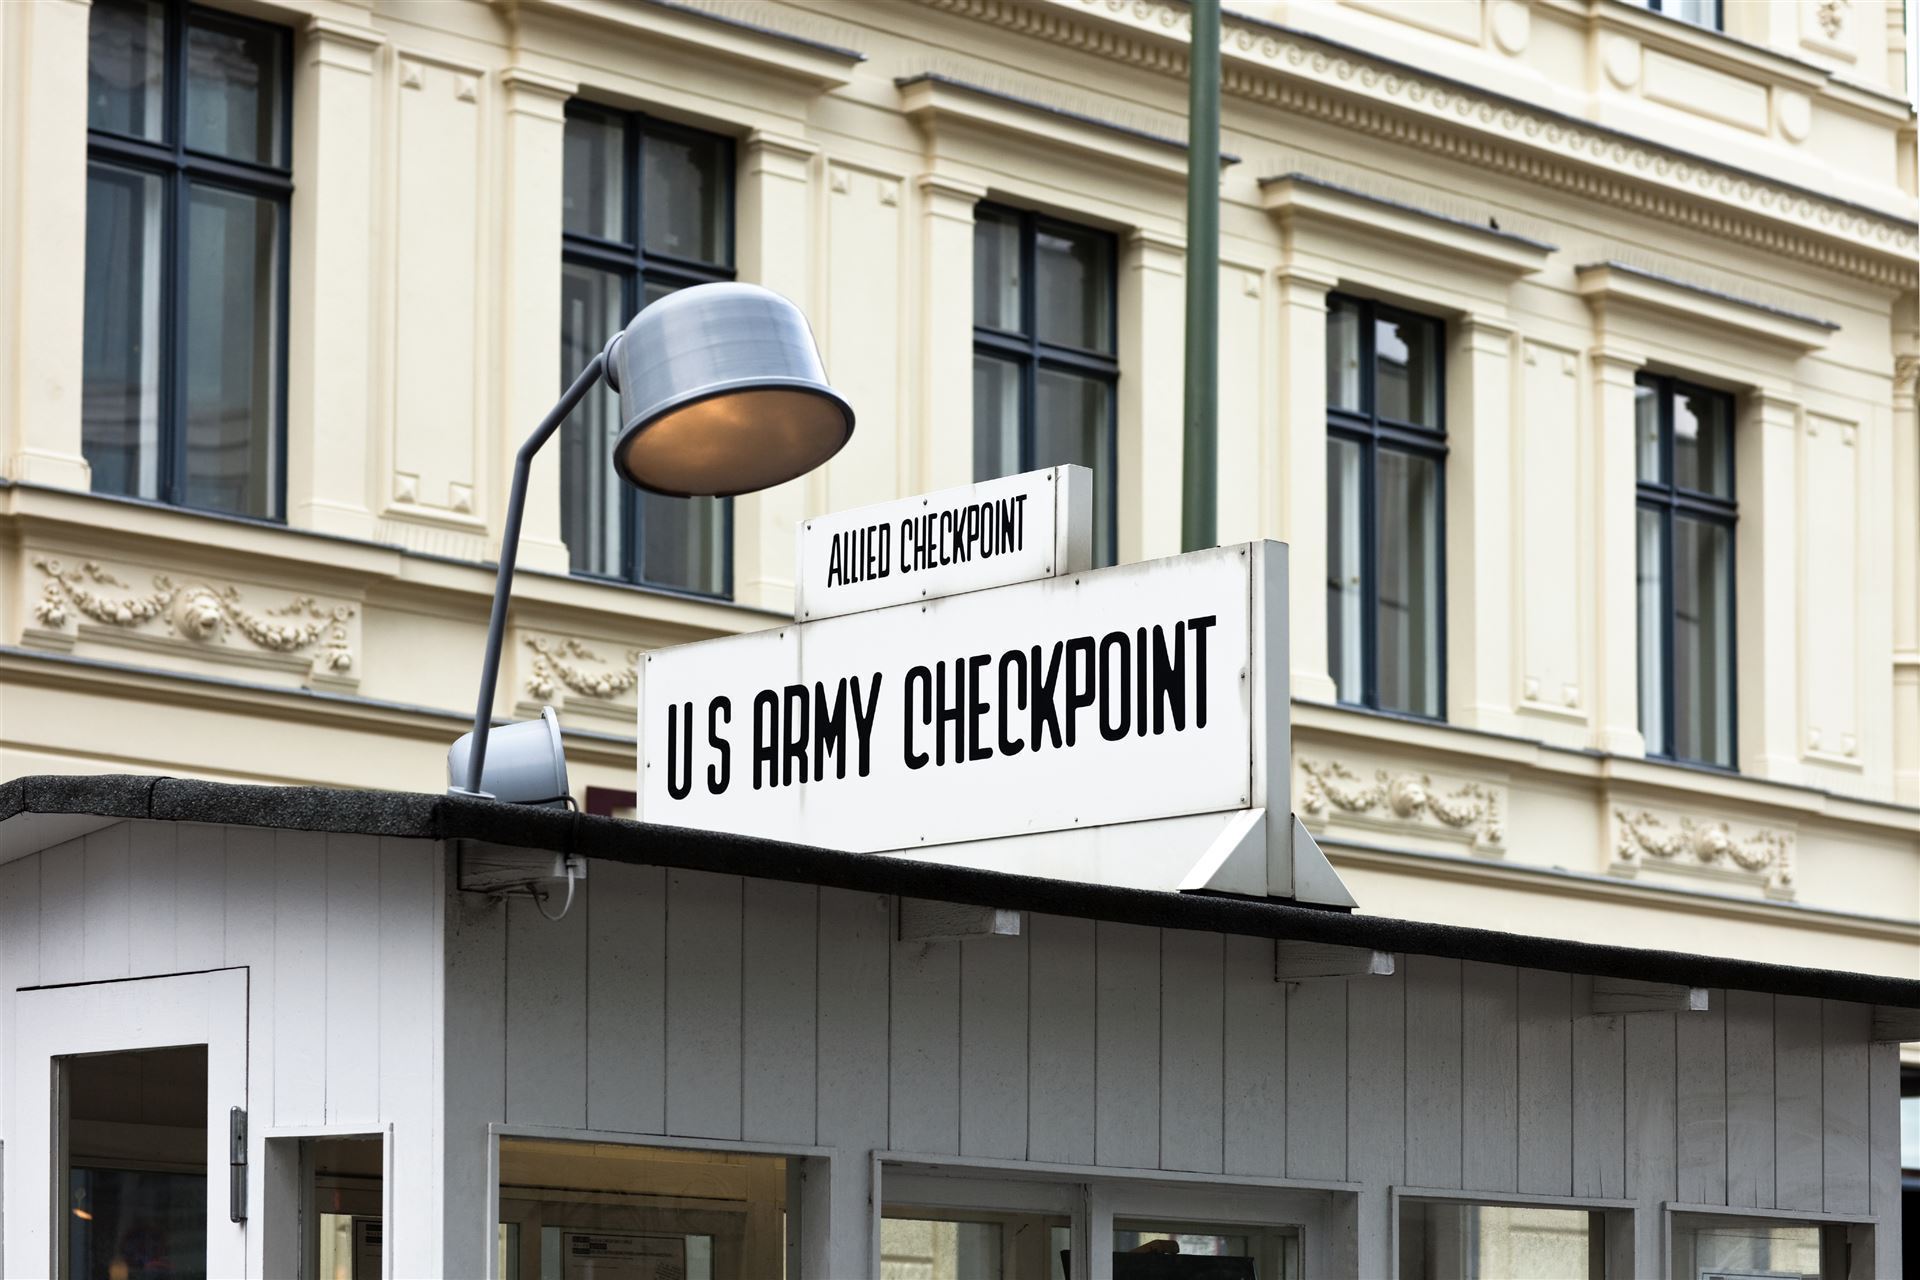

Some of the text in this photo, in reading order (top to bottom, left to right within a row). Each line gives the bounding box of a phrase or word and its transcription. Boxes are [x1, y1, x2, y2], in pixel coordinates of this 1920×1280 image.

[827, 494, 1028, 588] ALLIED CHECKPOINT
[667, 615, 1217, 800] U S ARMY CHECKPOINT
